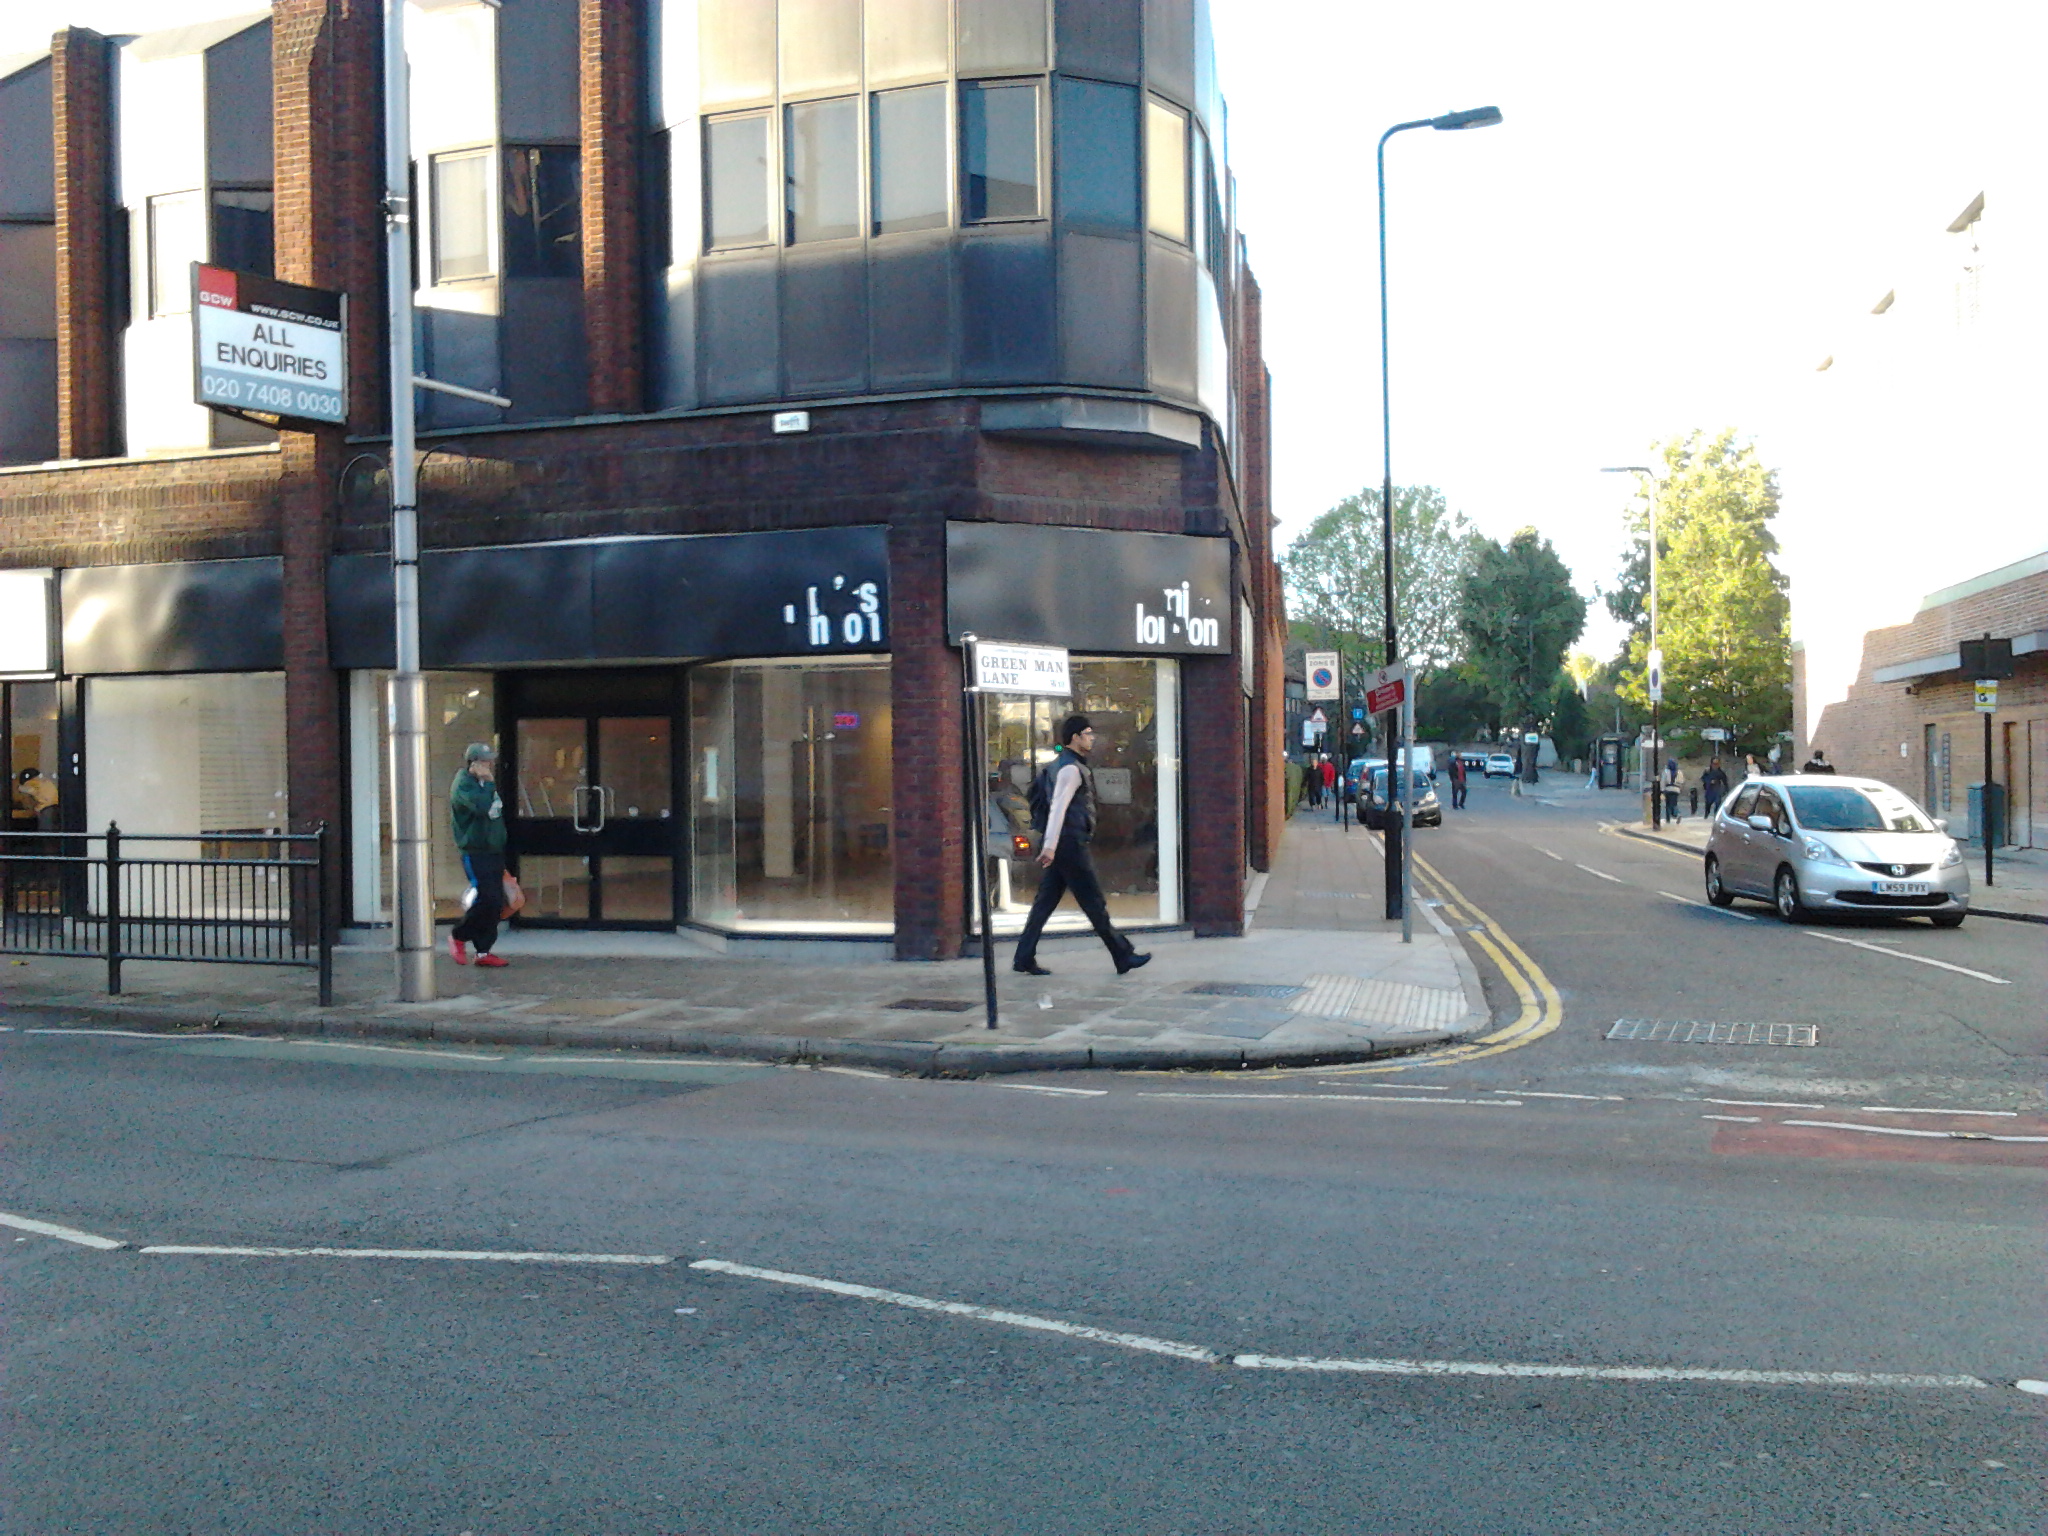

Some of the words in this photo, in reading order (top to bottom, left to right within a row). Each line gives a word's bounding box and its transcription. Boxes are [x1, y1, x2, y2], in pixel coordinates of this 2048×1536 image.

[252, 323, 295, 348] ALL
[217, 342, 327, 380] ENQUIRIES
[203, 374, 240, 400] 020
[245, 381, 293, 408] 7408
[297, 390, 342, 416] 0030
[981, 655, 1028, 671] GREEN
[1034, 660, 1063, 673] MAN
[982, 671, 1019, 685] LANE
